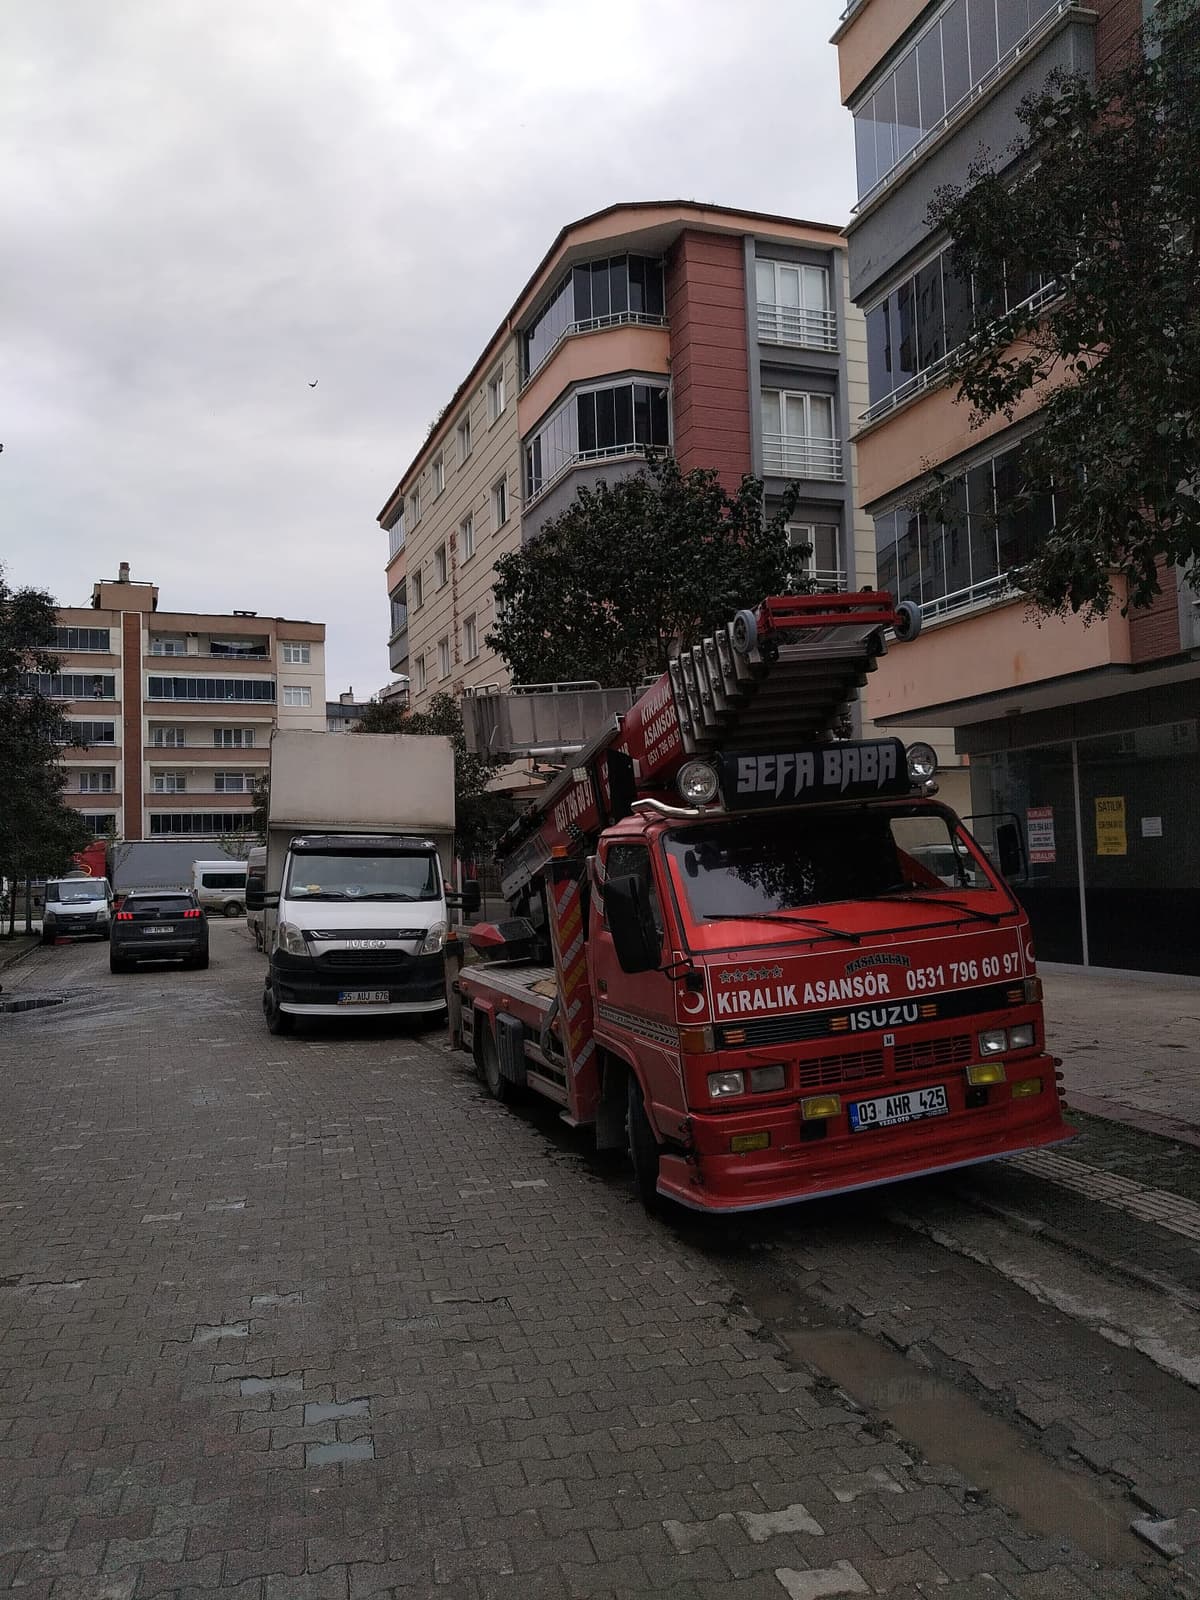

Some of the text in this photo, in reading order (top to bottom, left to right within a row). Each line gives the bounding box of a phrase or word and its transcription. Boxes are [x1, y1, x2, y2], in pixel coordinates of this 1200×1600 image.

[644, 704, 677, 749] ASANSÖR
[737, 744, 897, 800] SEFA BABA
[346, 939, 386, 949] IVECO
[906, 951, 1019, 991] 0531 796 60 97
[803, 972, 890, 1004] ASANSÖR
[850, 1003, 918, 1031] ISUZU
[859, 1102, 877, 1122] 03
[886, 1095, 911, 1117] AHR
[919, 1089, 944, 1109] 425
